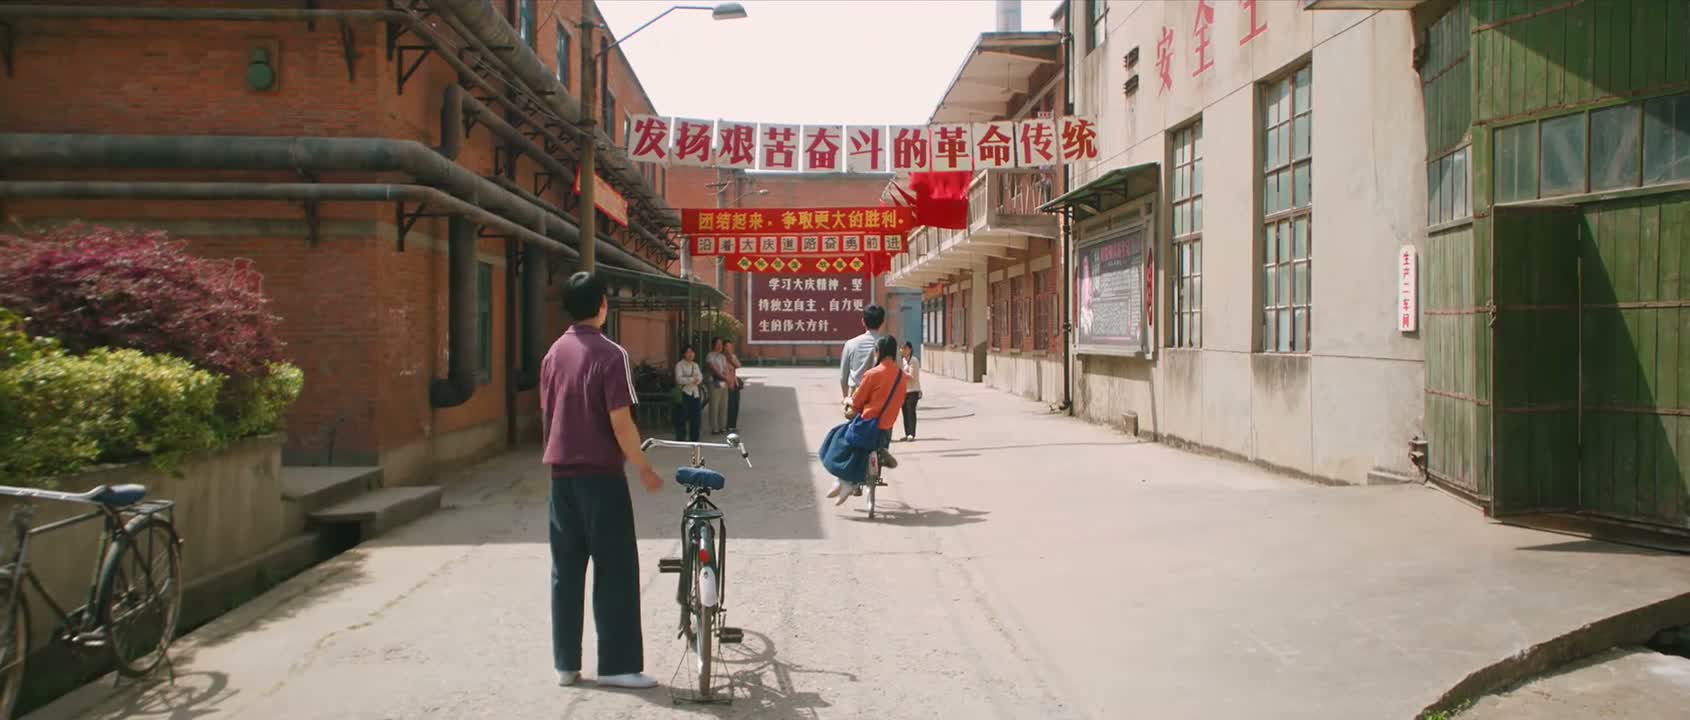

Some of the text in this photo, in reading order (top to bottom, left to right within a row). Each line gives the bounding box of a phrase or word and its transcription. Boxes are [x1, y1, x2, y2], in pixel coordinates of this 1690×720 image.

[632, 118, 1098, 169] 发扬艰苦奋斗的革命传统
[699, 235, 901, 251] 沿着大庆道路奋勇前进
[1402, 251, 1410, 329] 生产二车间
